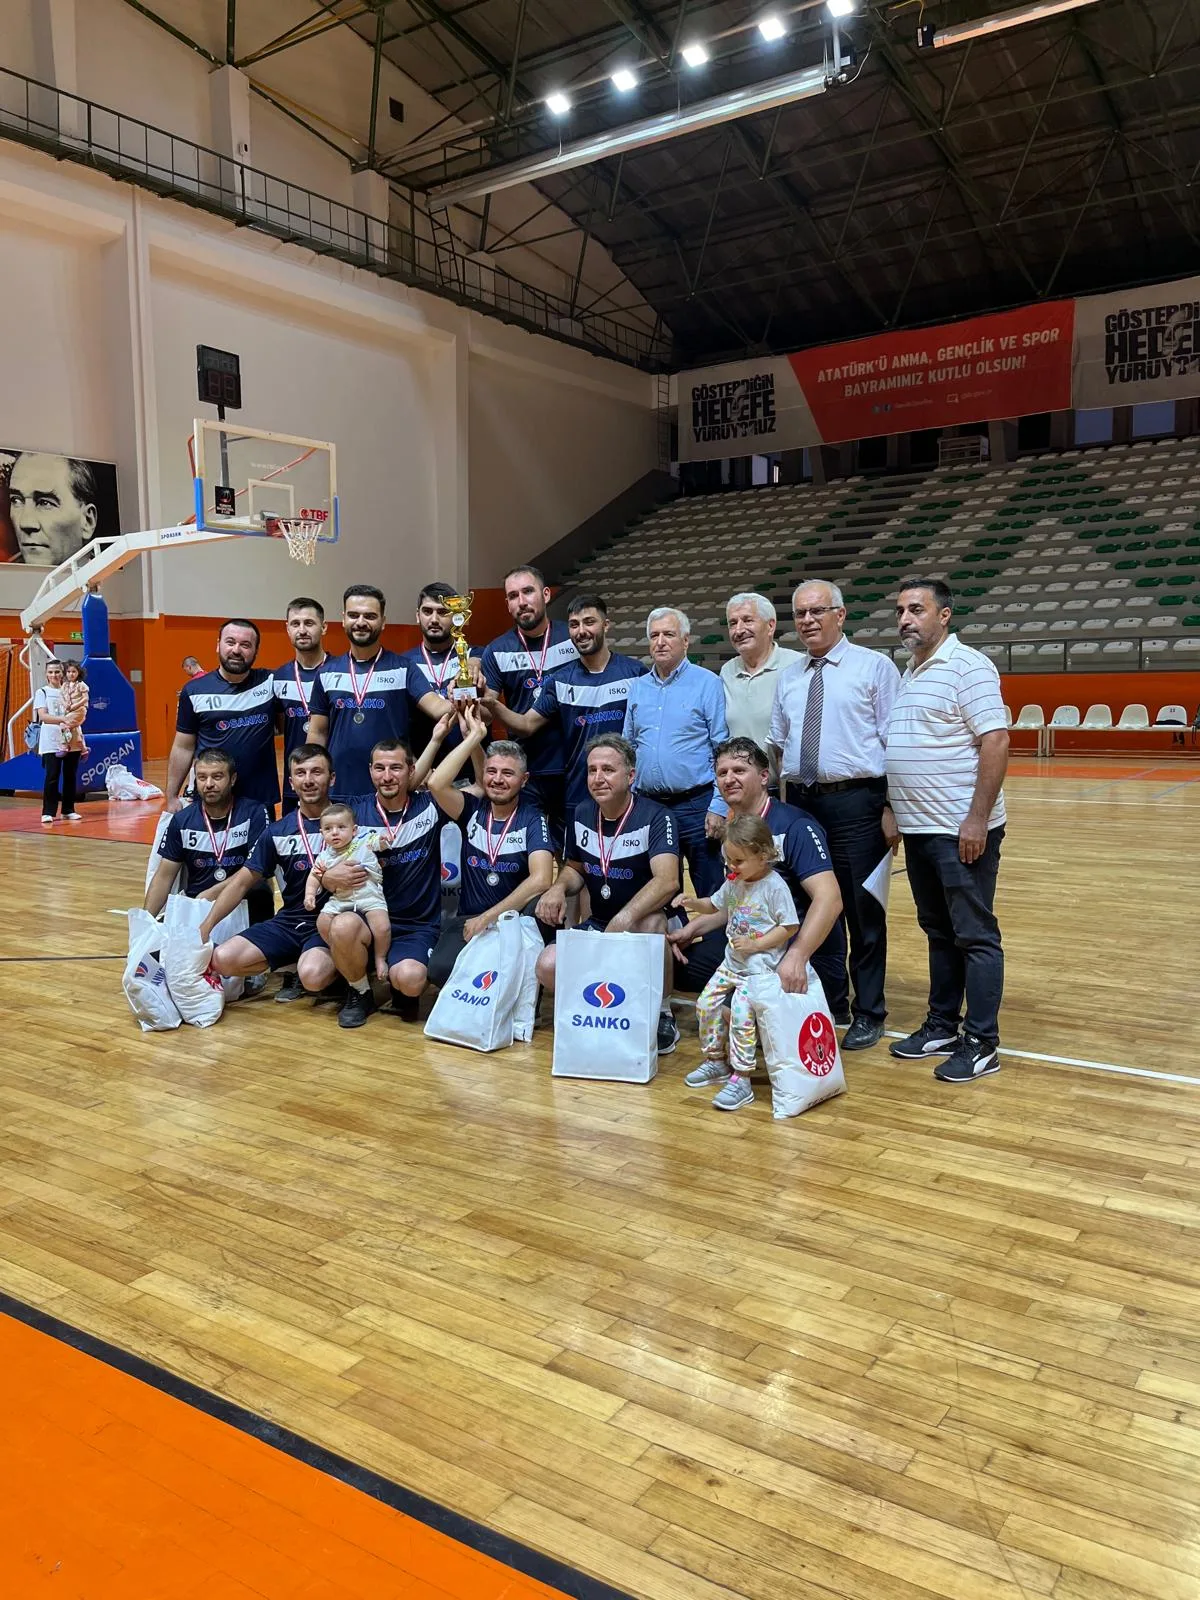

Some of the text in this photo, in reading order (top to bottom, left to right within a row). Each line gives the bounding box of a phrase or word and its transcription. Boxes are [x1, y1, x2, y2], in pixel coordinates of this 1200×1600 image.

[818, 327, 1060, 383] ATATÜRK'Ü ANMA, GENÇLİK VE SPOR
[844, 355, 1026, 397] BAYRAMIMIZ KUTLU OLSUN!
[692, 389, 775, 427] HEDEFE
[310, 509, 329, 521] TBF
[558, 647, 575, 655] ISKO
[511, 653, 528, 669] 12
[334, 674, 342, 688] 7
[377, 676, 395, 684] ISKO
[281, 682, 288, 697] 4
[568, 687, 574, 702] 1
[609, 687, 627, 695] ISKO
[206, 696, 222, 710] 10
[230, 713, 269, 728] SANKO
[587, 710, 624, 725] SANKO
[81, 739, 135, 786] SPORSAN
[232, 830, 248, 838] ISKO
[665, 815, 673, 846] SANKO
[189, 832, 197, 847] 5
[289, 838, 298, 854] 2
[507, 836, 523, 844] ISKO
[581, 830, 589, 848] 8
[622, 839, 641, 847] ISKO
[806, 825, 827, 860] SANKO
[572, 1014, 630, 1030] SANKO
